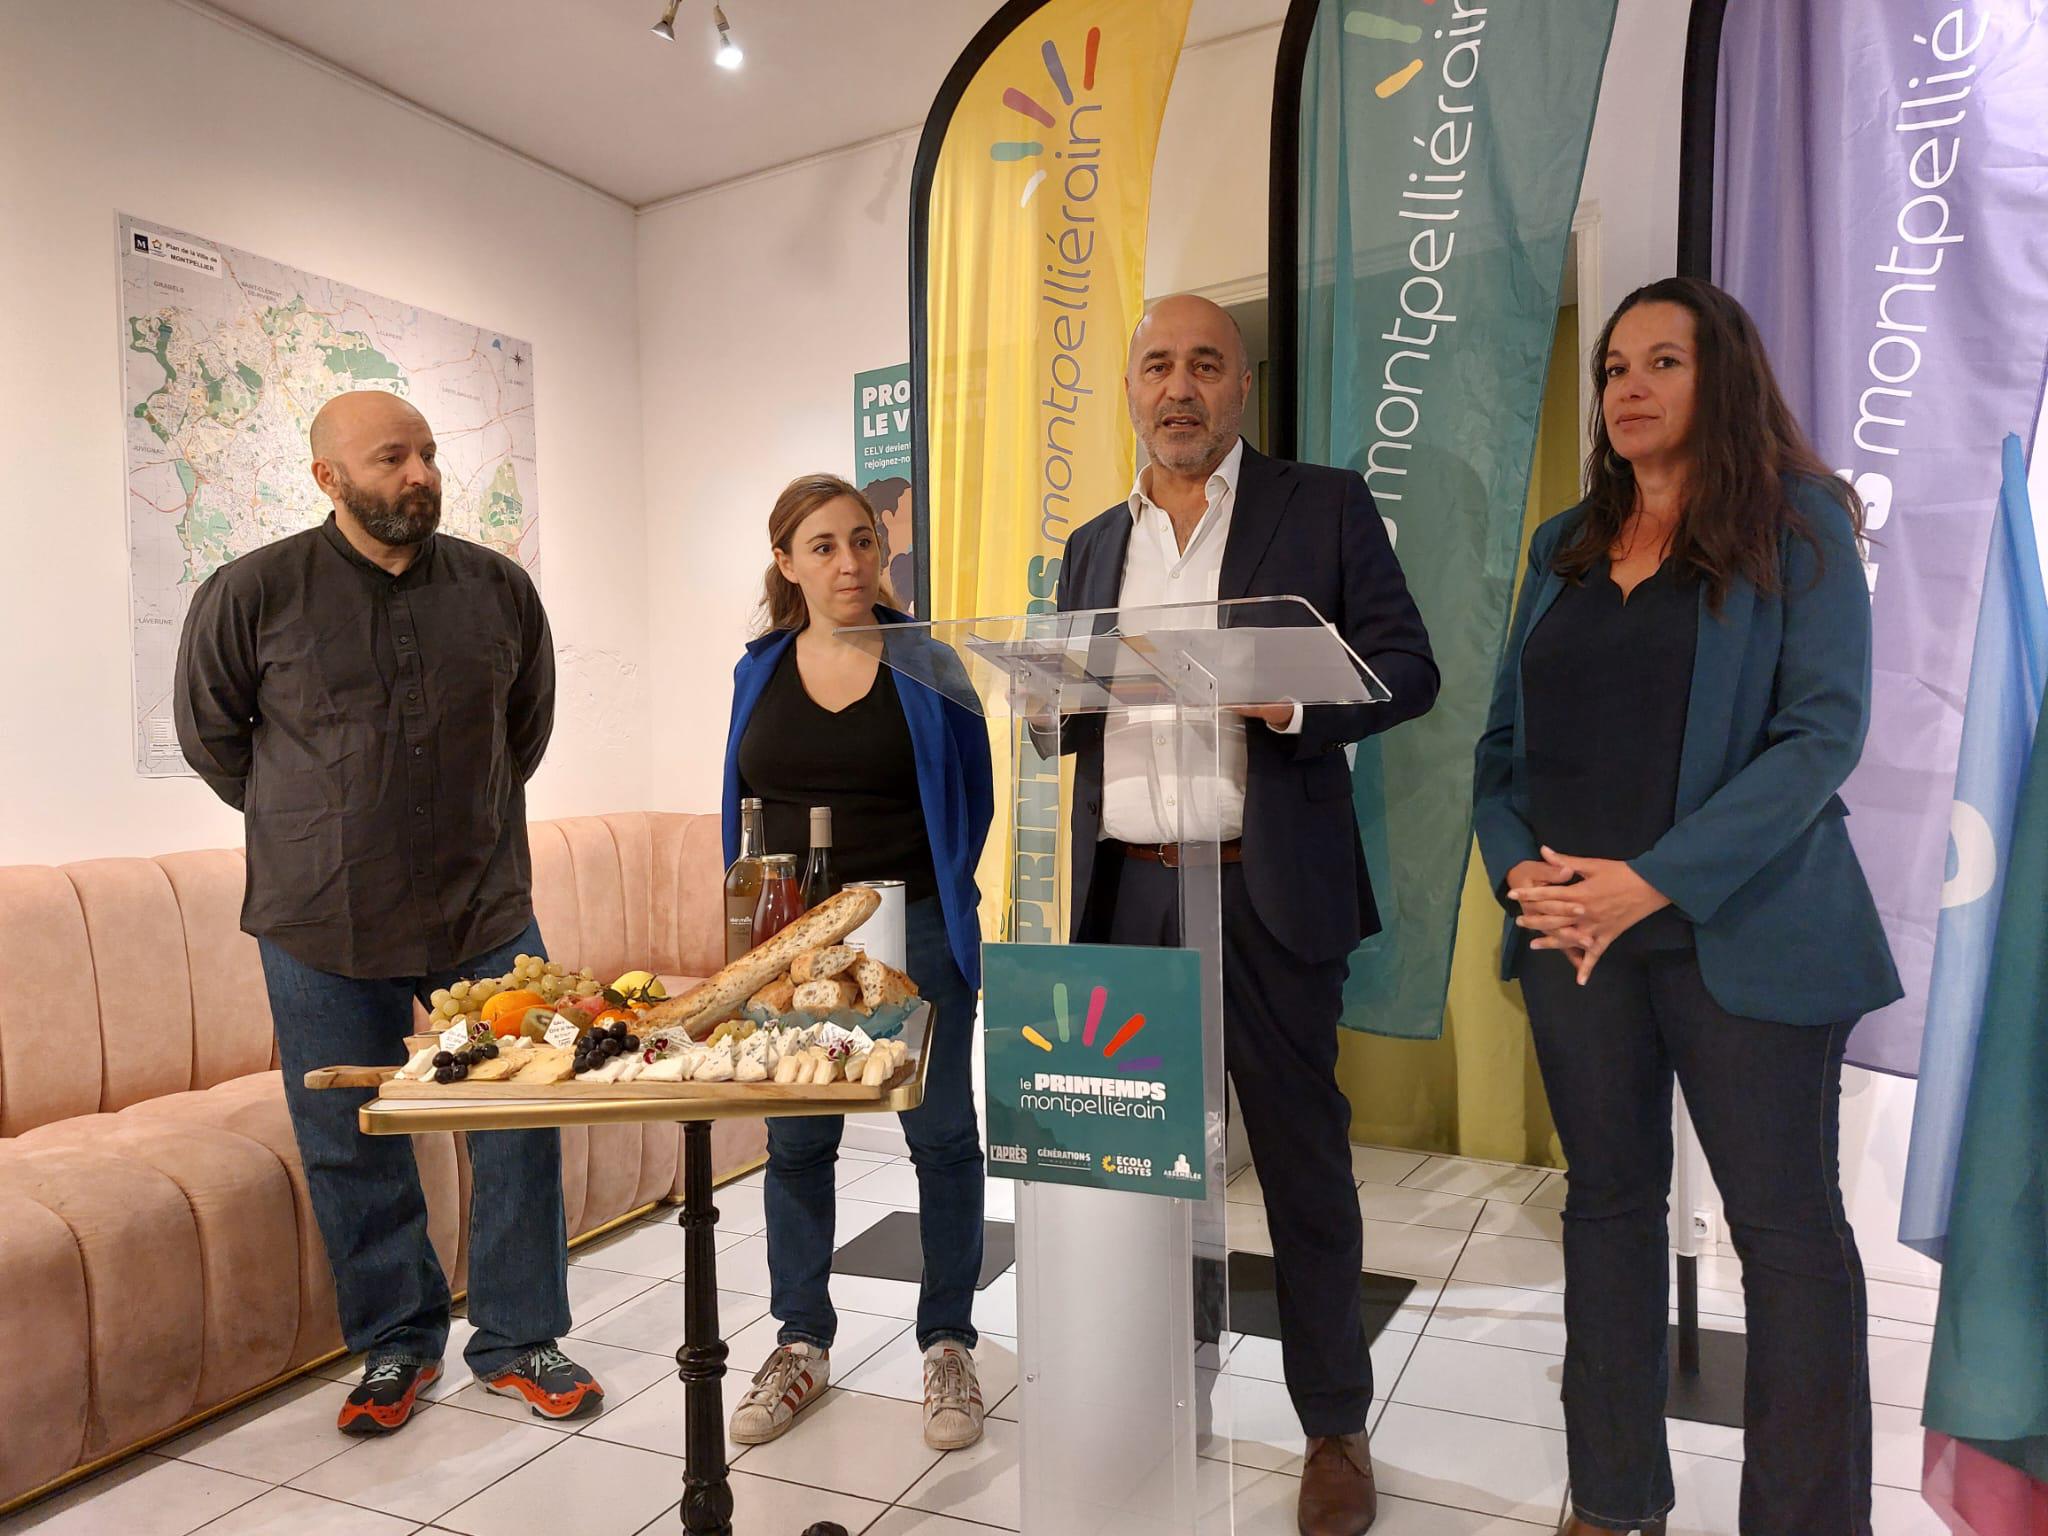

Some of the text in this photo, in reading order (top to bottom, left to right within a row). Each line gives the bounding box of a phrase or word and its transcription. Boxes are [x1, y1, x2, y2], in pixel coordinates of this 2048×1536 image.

[165, 243, 180, 252] Plan
[196, 252, 209, 261] Ville
[170, 254, 215, 272] MONTPELLIER
[1041, 103, 1103, 545] montpelliérain
[863, 413, 889, 438] LE
[864, 444, 884, 456] EELV
[1020, 1073, 1167, 1101] le PRINTEMPS
[1020, 1094, 1166, 1121] montpelliérain
[1116, 1165, 1152, 1177] GISTES
